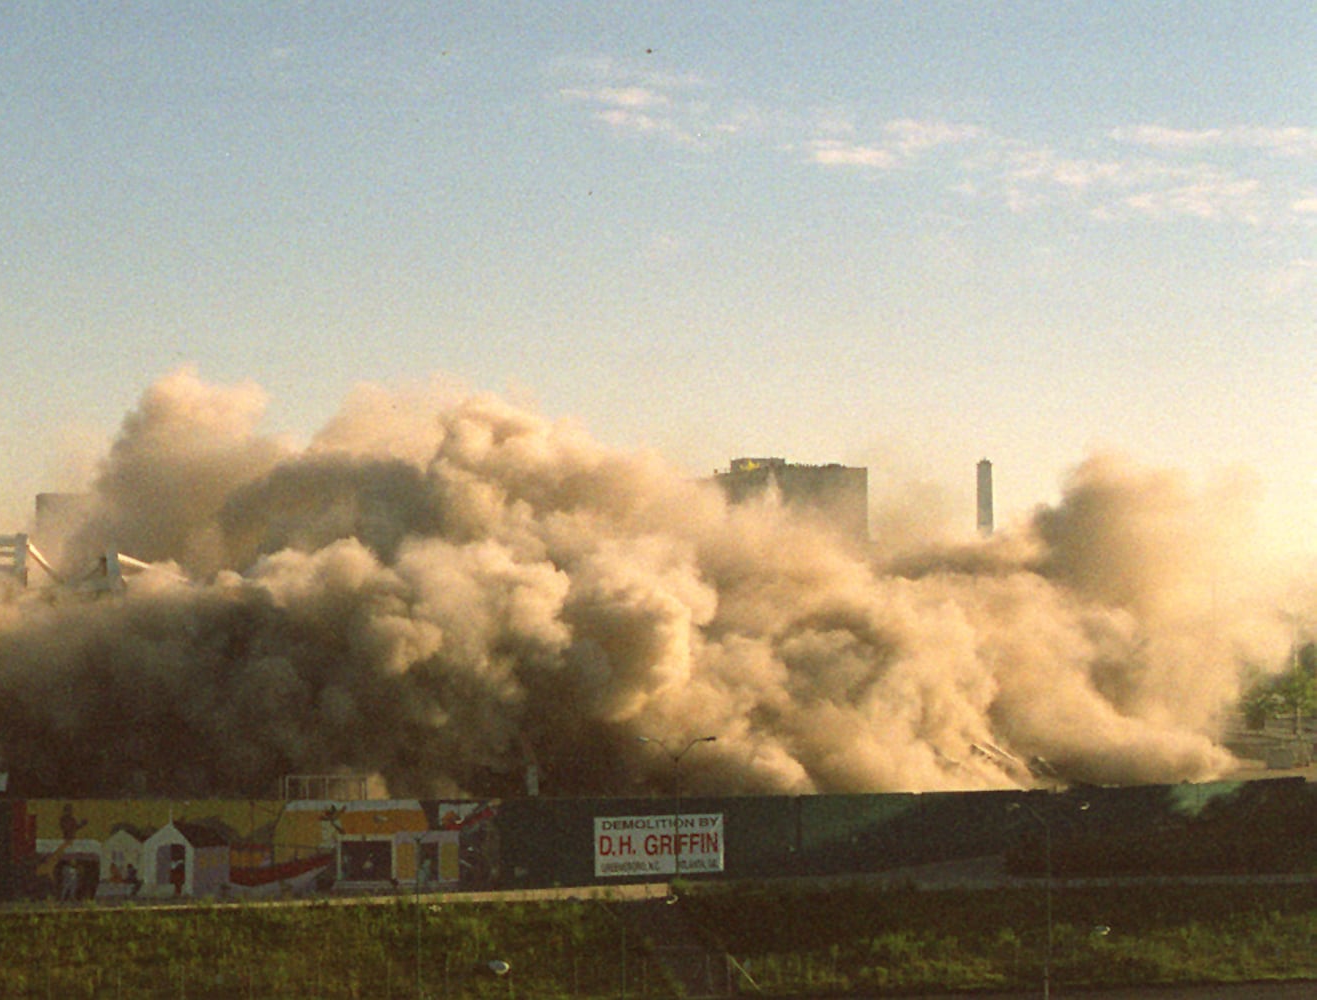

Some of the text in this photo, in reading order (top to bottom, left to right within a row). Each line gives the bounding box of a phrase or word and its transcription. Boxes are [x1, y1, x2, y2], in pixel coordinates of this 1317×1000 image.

[601, 817, 719, 830] DEMOLITION BY
[599, 832, 719, 856] D.H. GRIFFIN
